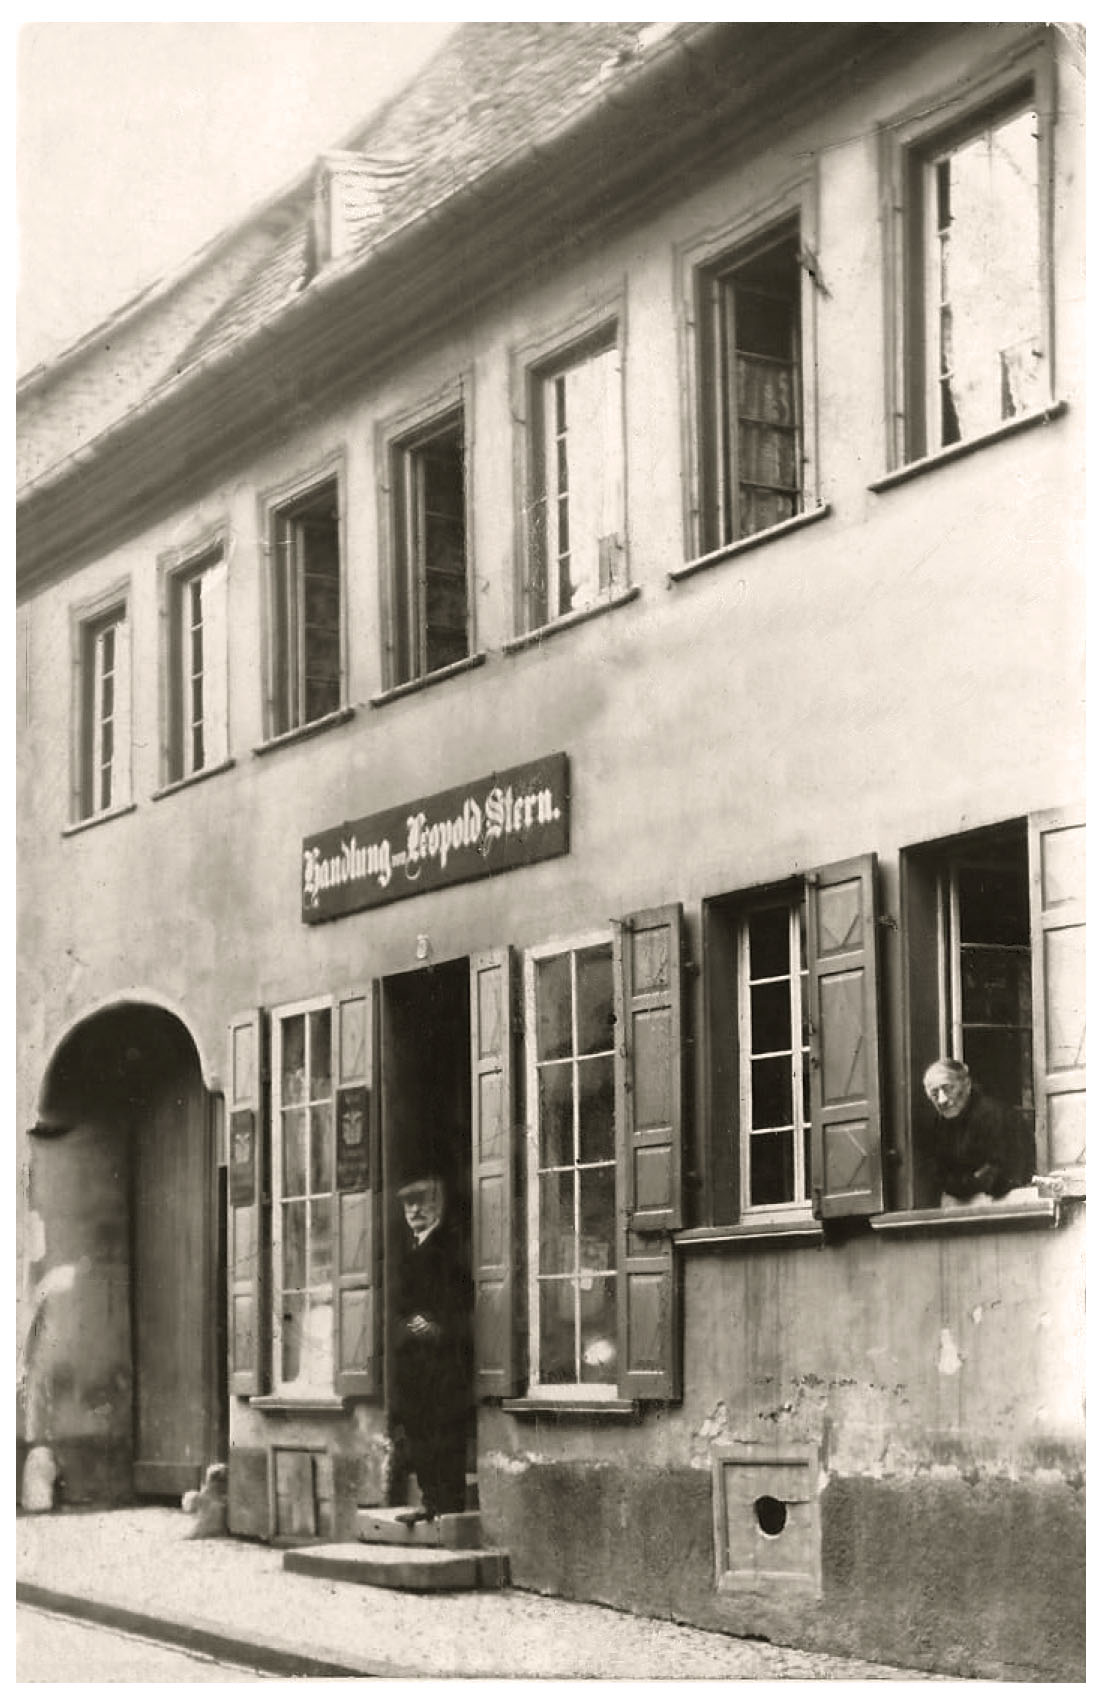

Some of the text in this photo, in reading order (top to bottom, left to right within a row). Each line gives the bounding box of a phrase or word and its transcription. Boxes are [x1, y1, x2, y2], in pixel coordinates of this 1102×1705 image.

[304, 834, 391, 907] Handlung
[405, 797, 482, 880] Leopold
[477, 786, 560, 856] Stern.
